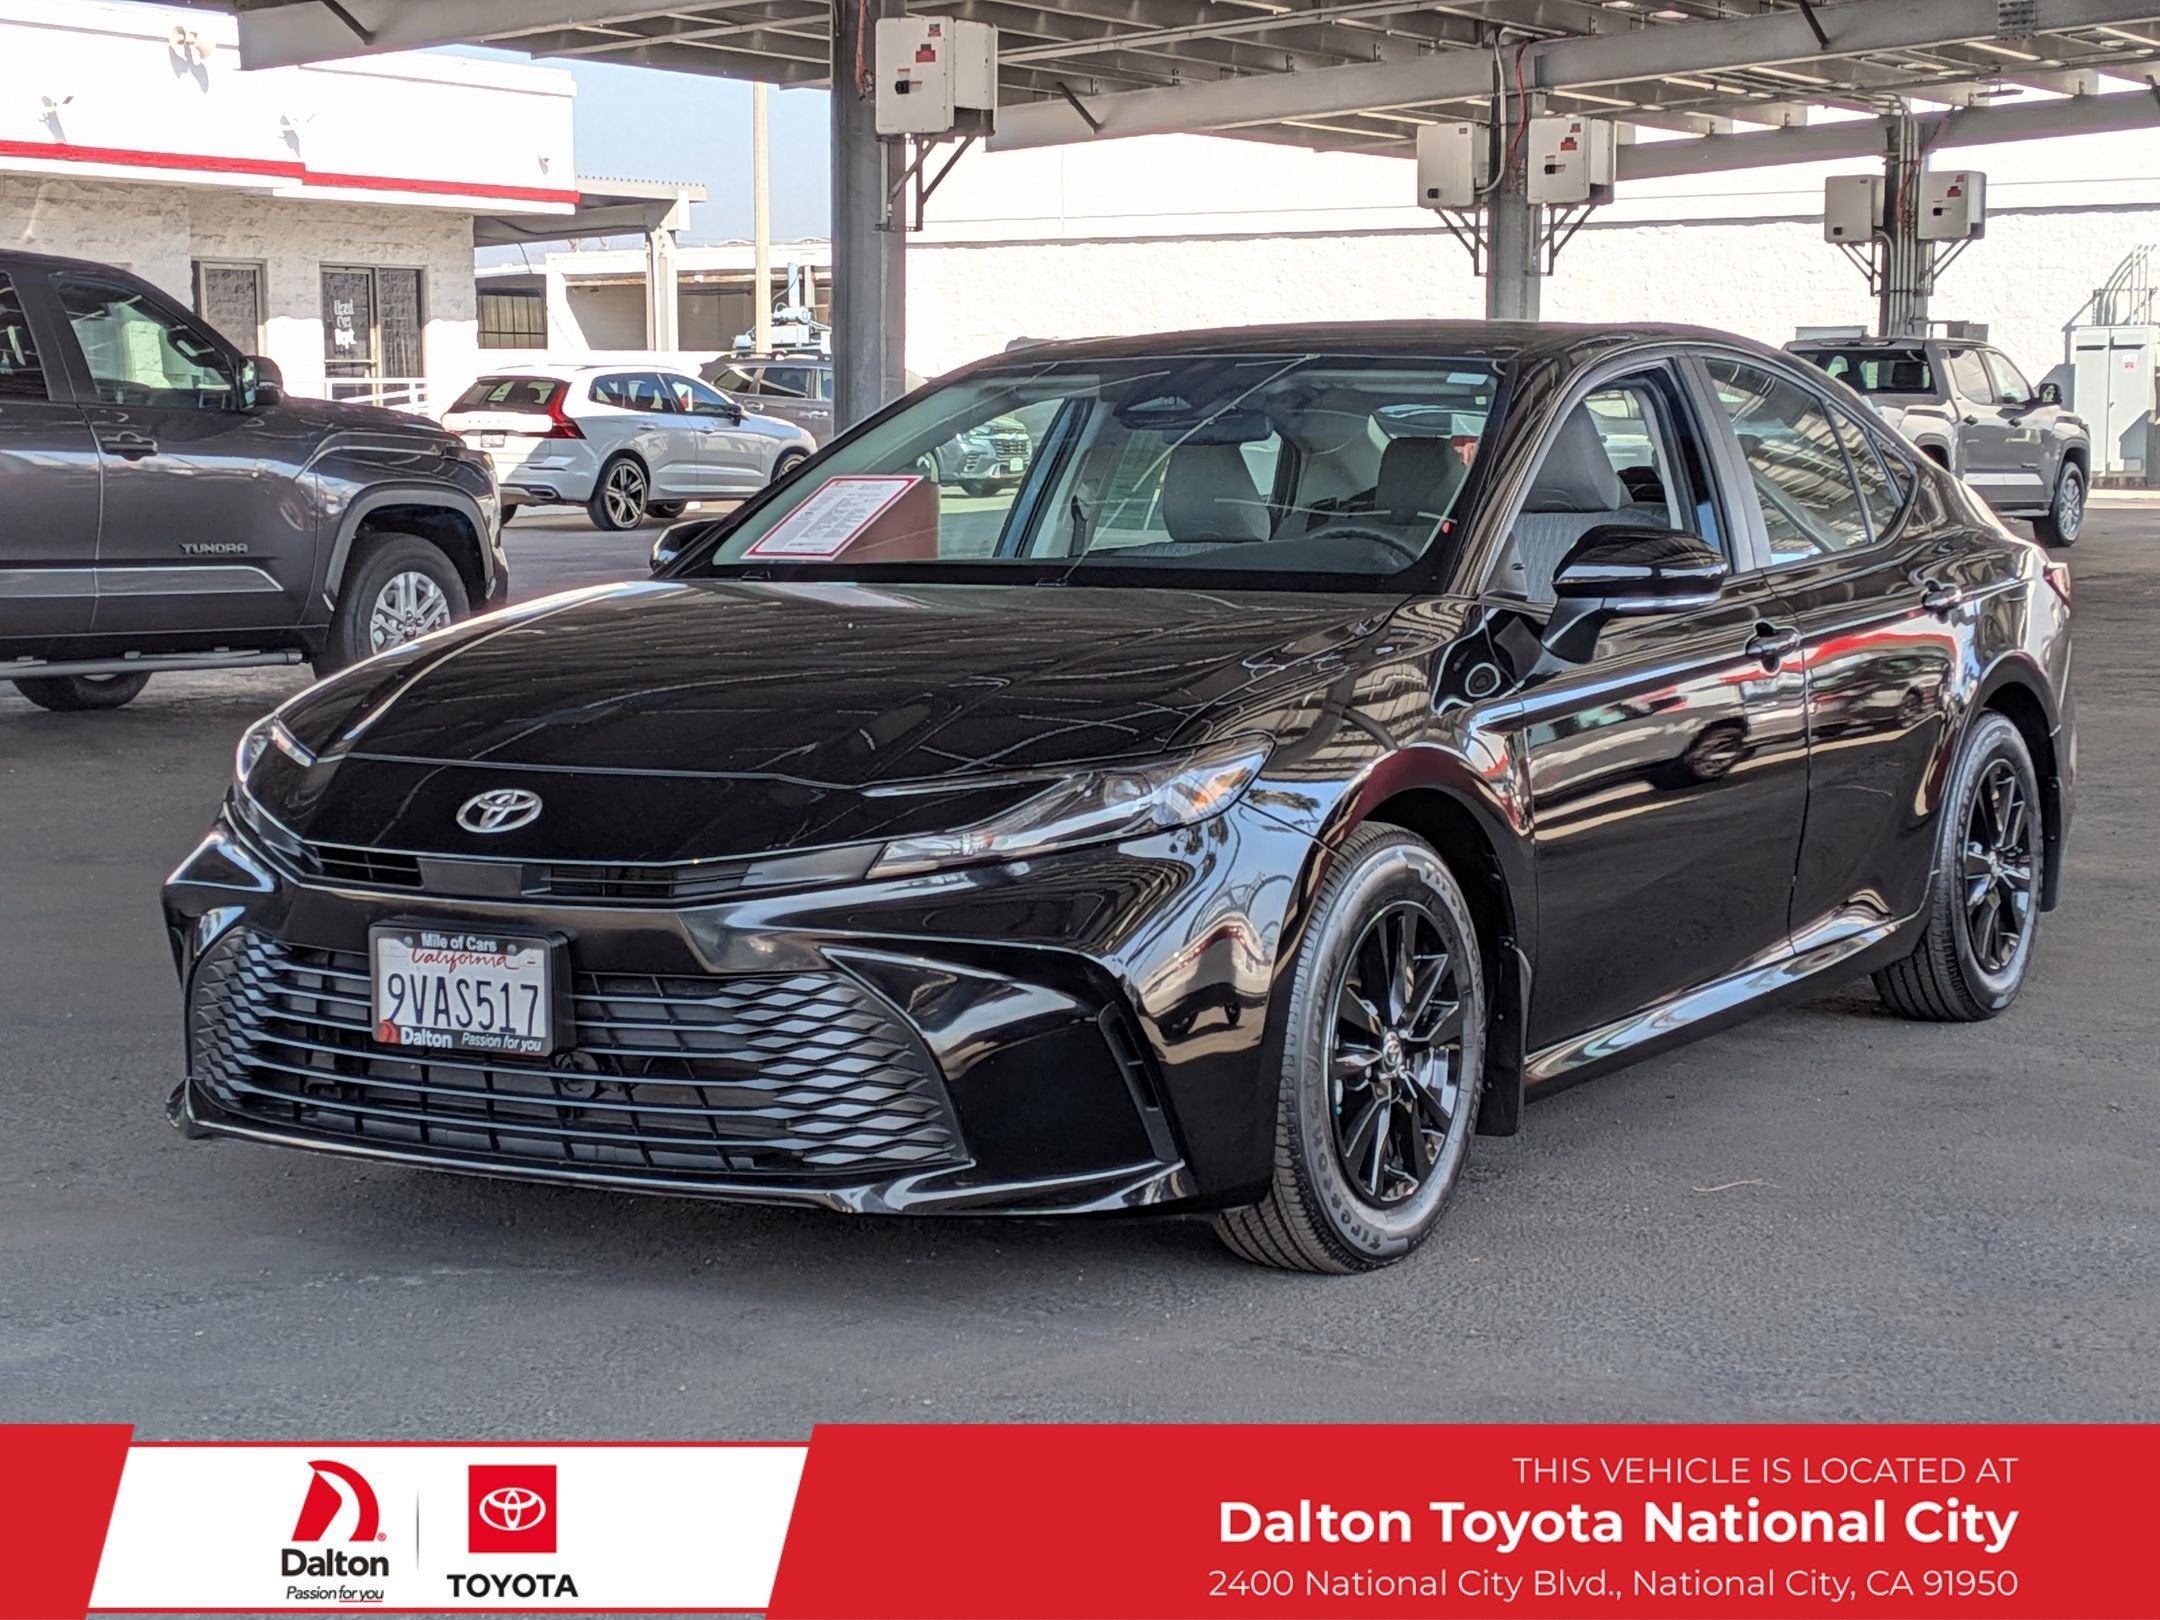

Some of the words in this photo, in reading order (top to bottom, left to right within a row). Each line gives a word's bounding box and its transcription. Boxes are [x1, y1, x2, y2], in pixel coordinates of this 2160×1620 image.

[180, 543, 249, 553] TUNDRA
[421, 932, 448, 949] Mile
[450, 936, 464, 950] of
[466, 936, 498, 953] Cars
[411, 948, 519, 974] California
[387, 972, 539, 1036] 9VAS517
[400, 1026, 453, 1049] Dalton
[461, 1032, 501, 1048] Passion
[503, 1035, 519, 1048] for
[520, 1040, 543, 1053] you
